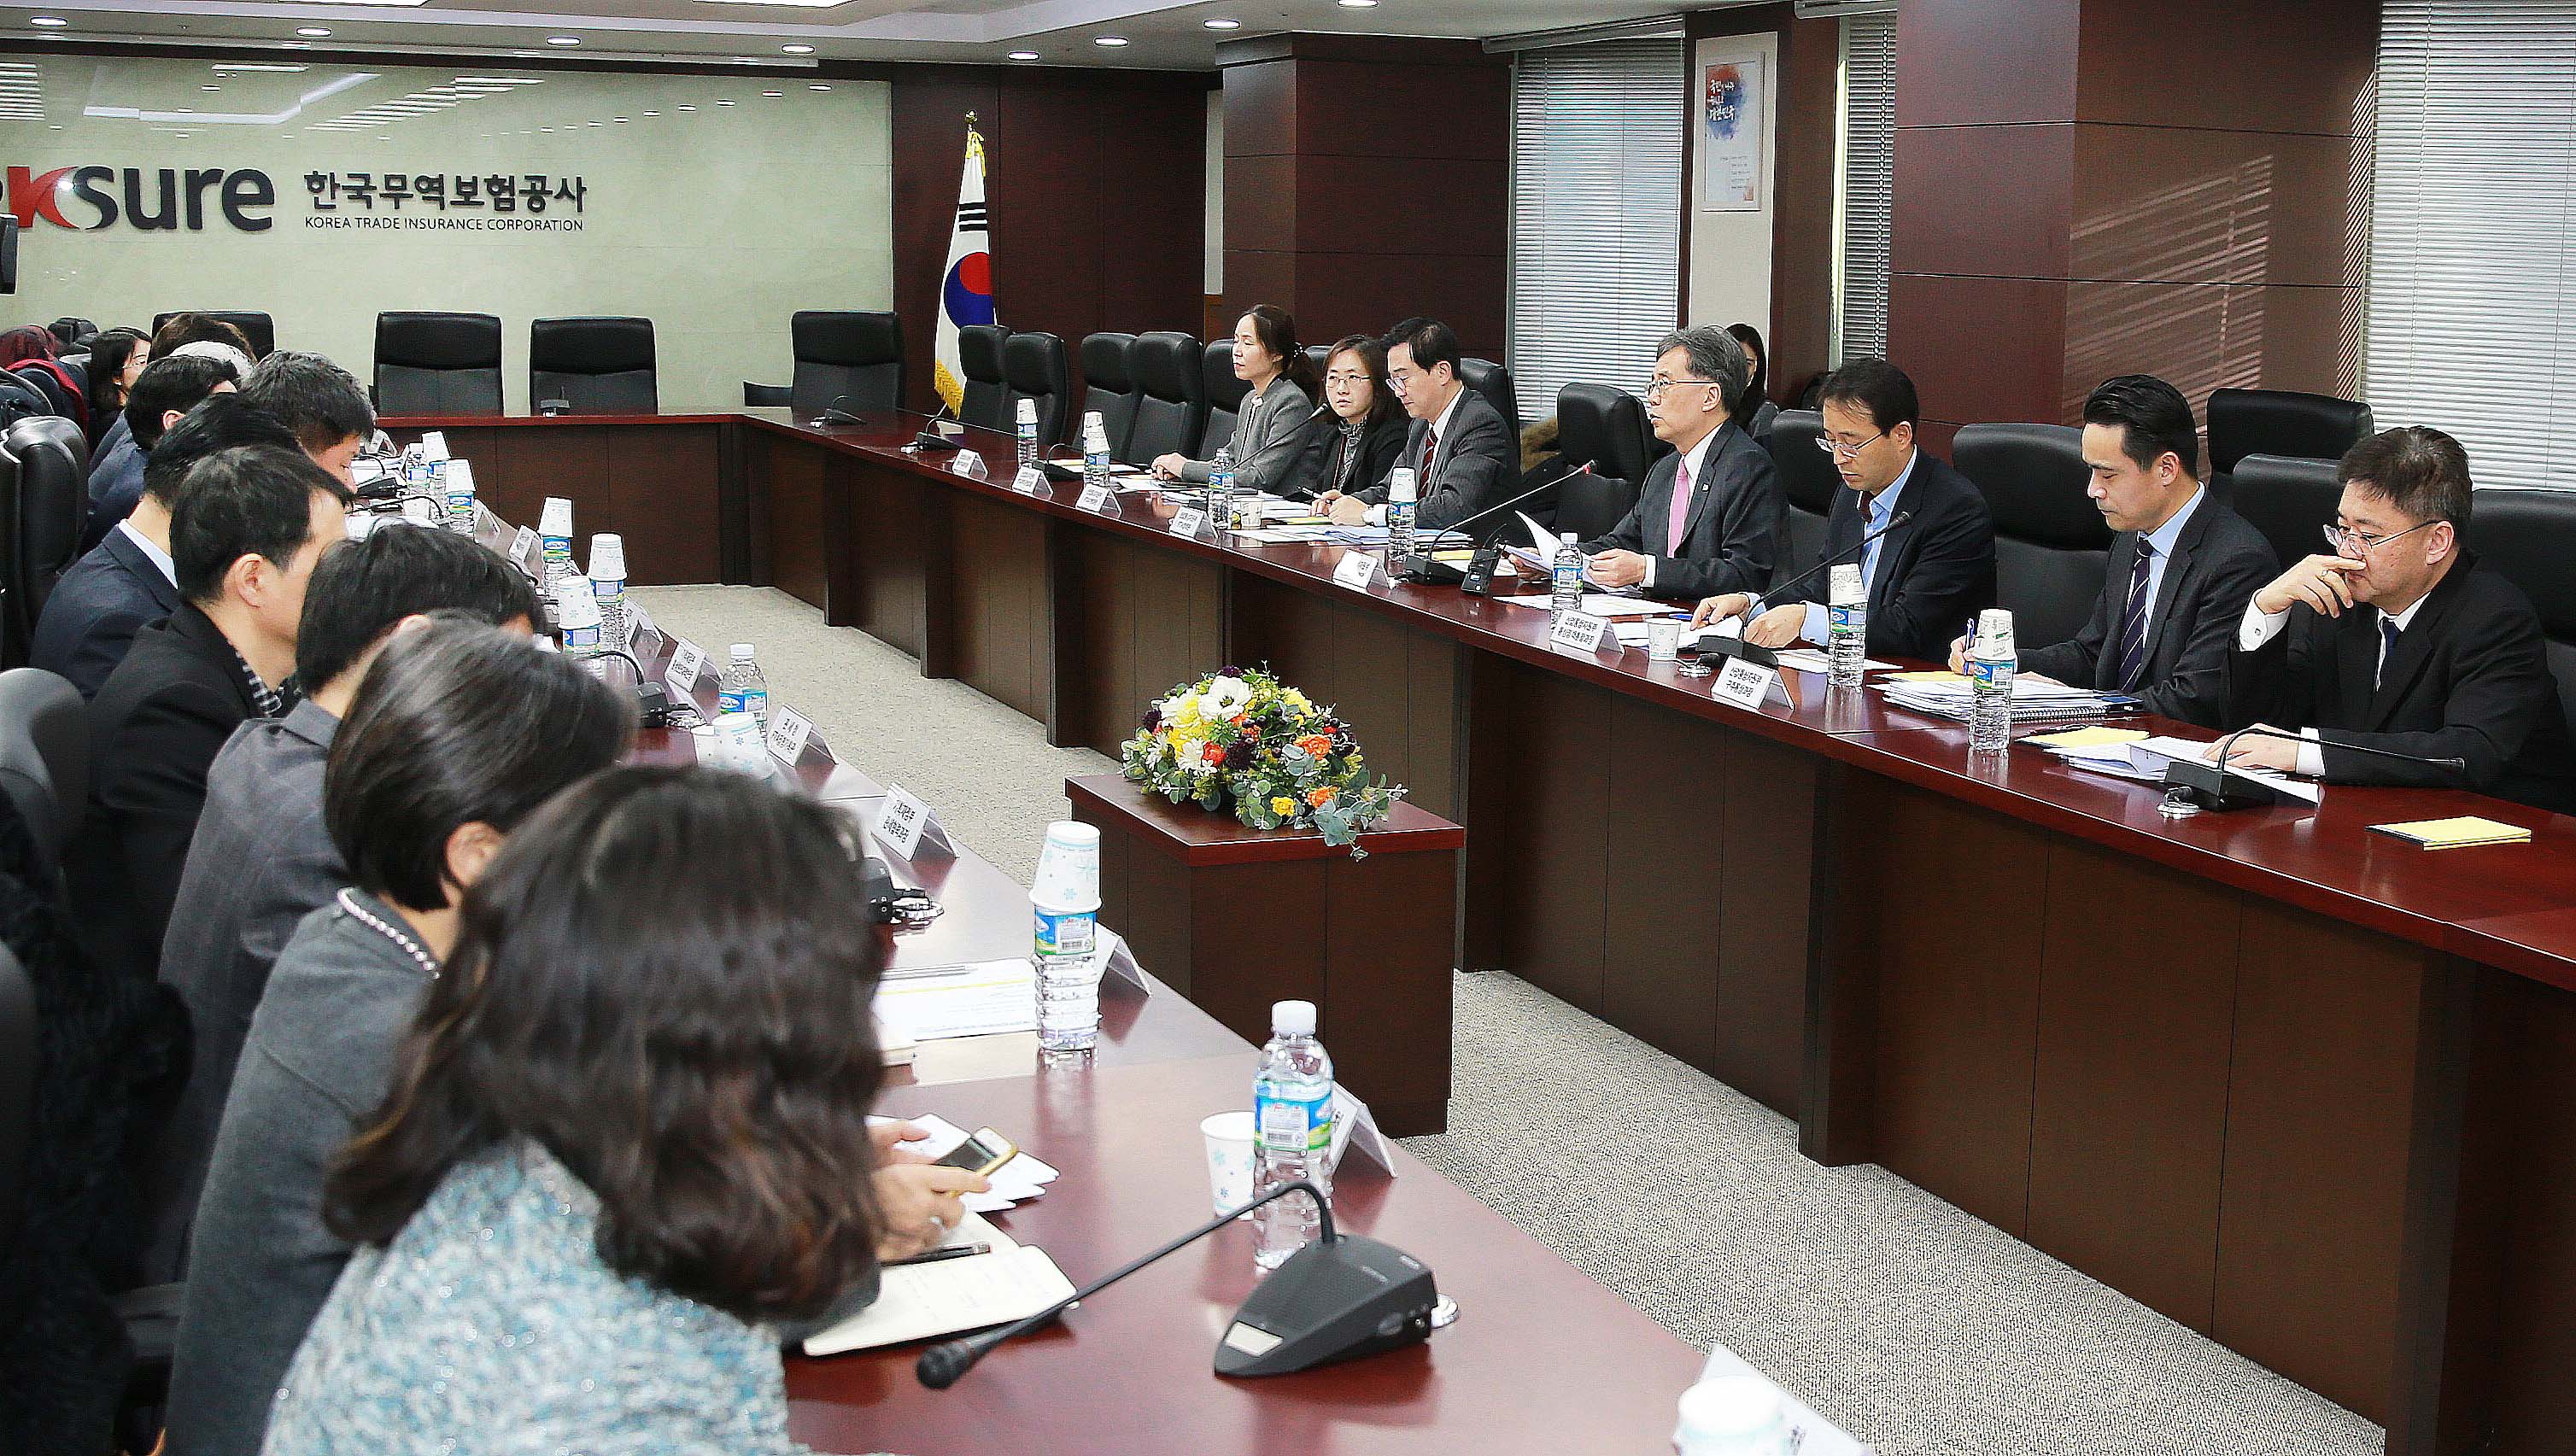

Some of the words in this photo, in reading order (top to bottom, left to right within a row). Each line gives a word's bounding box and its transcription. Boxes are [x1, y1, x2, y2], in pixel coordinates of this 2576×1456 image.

[303, 171, 588, 213] 한국무역보험공사
[305, 216, 352, 229] KOREA
[354, 217, 401, 230] TRADE
[404, 218, 483, 231] INSURANCE
[487, 219, 583, 231] CORPORATION
